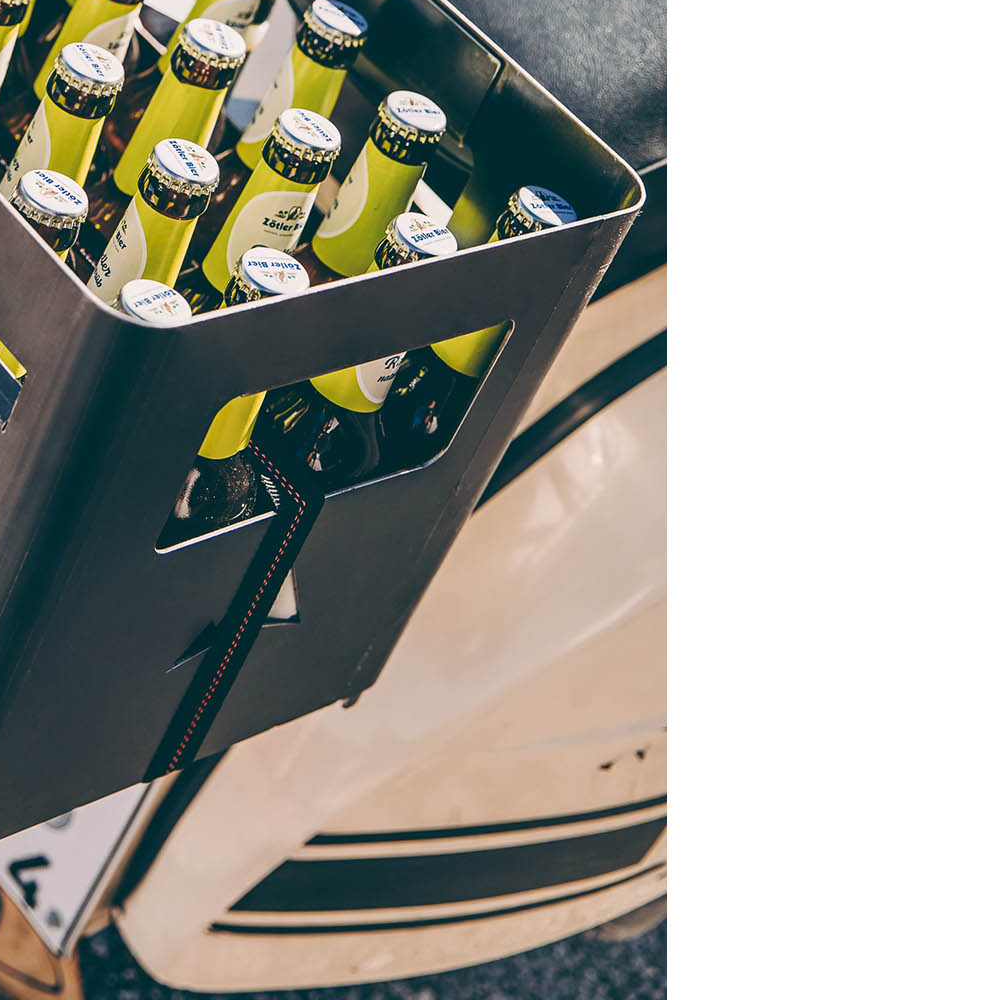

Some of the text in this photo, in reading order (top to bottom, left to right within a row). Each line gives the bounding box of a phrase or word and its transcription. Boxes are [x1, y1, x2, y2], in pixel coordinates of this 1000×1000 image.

[169, 140, 200, 177] Zötler Bier
[34, 170, 55, 185] Bier
[53, 183, 82, 206] Zötler
[262, 217, 293, 231] Zötler
[411, 228, 450, 243] Zötler Bier
[247, 259, 302, 271] Zötler Bier
